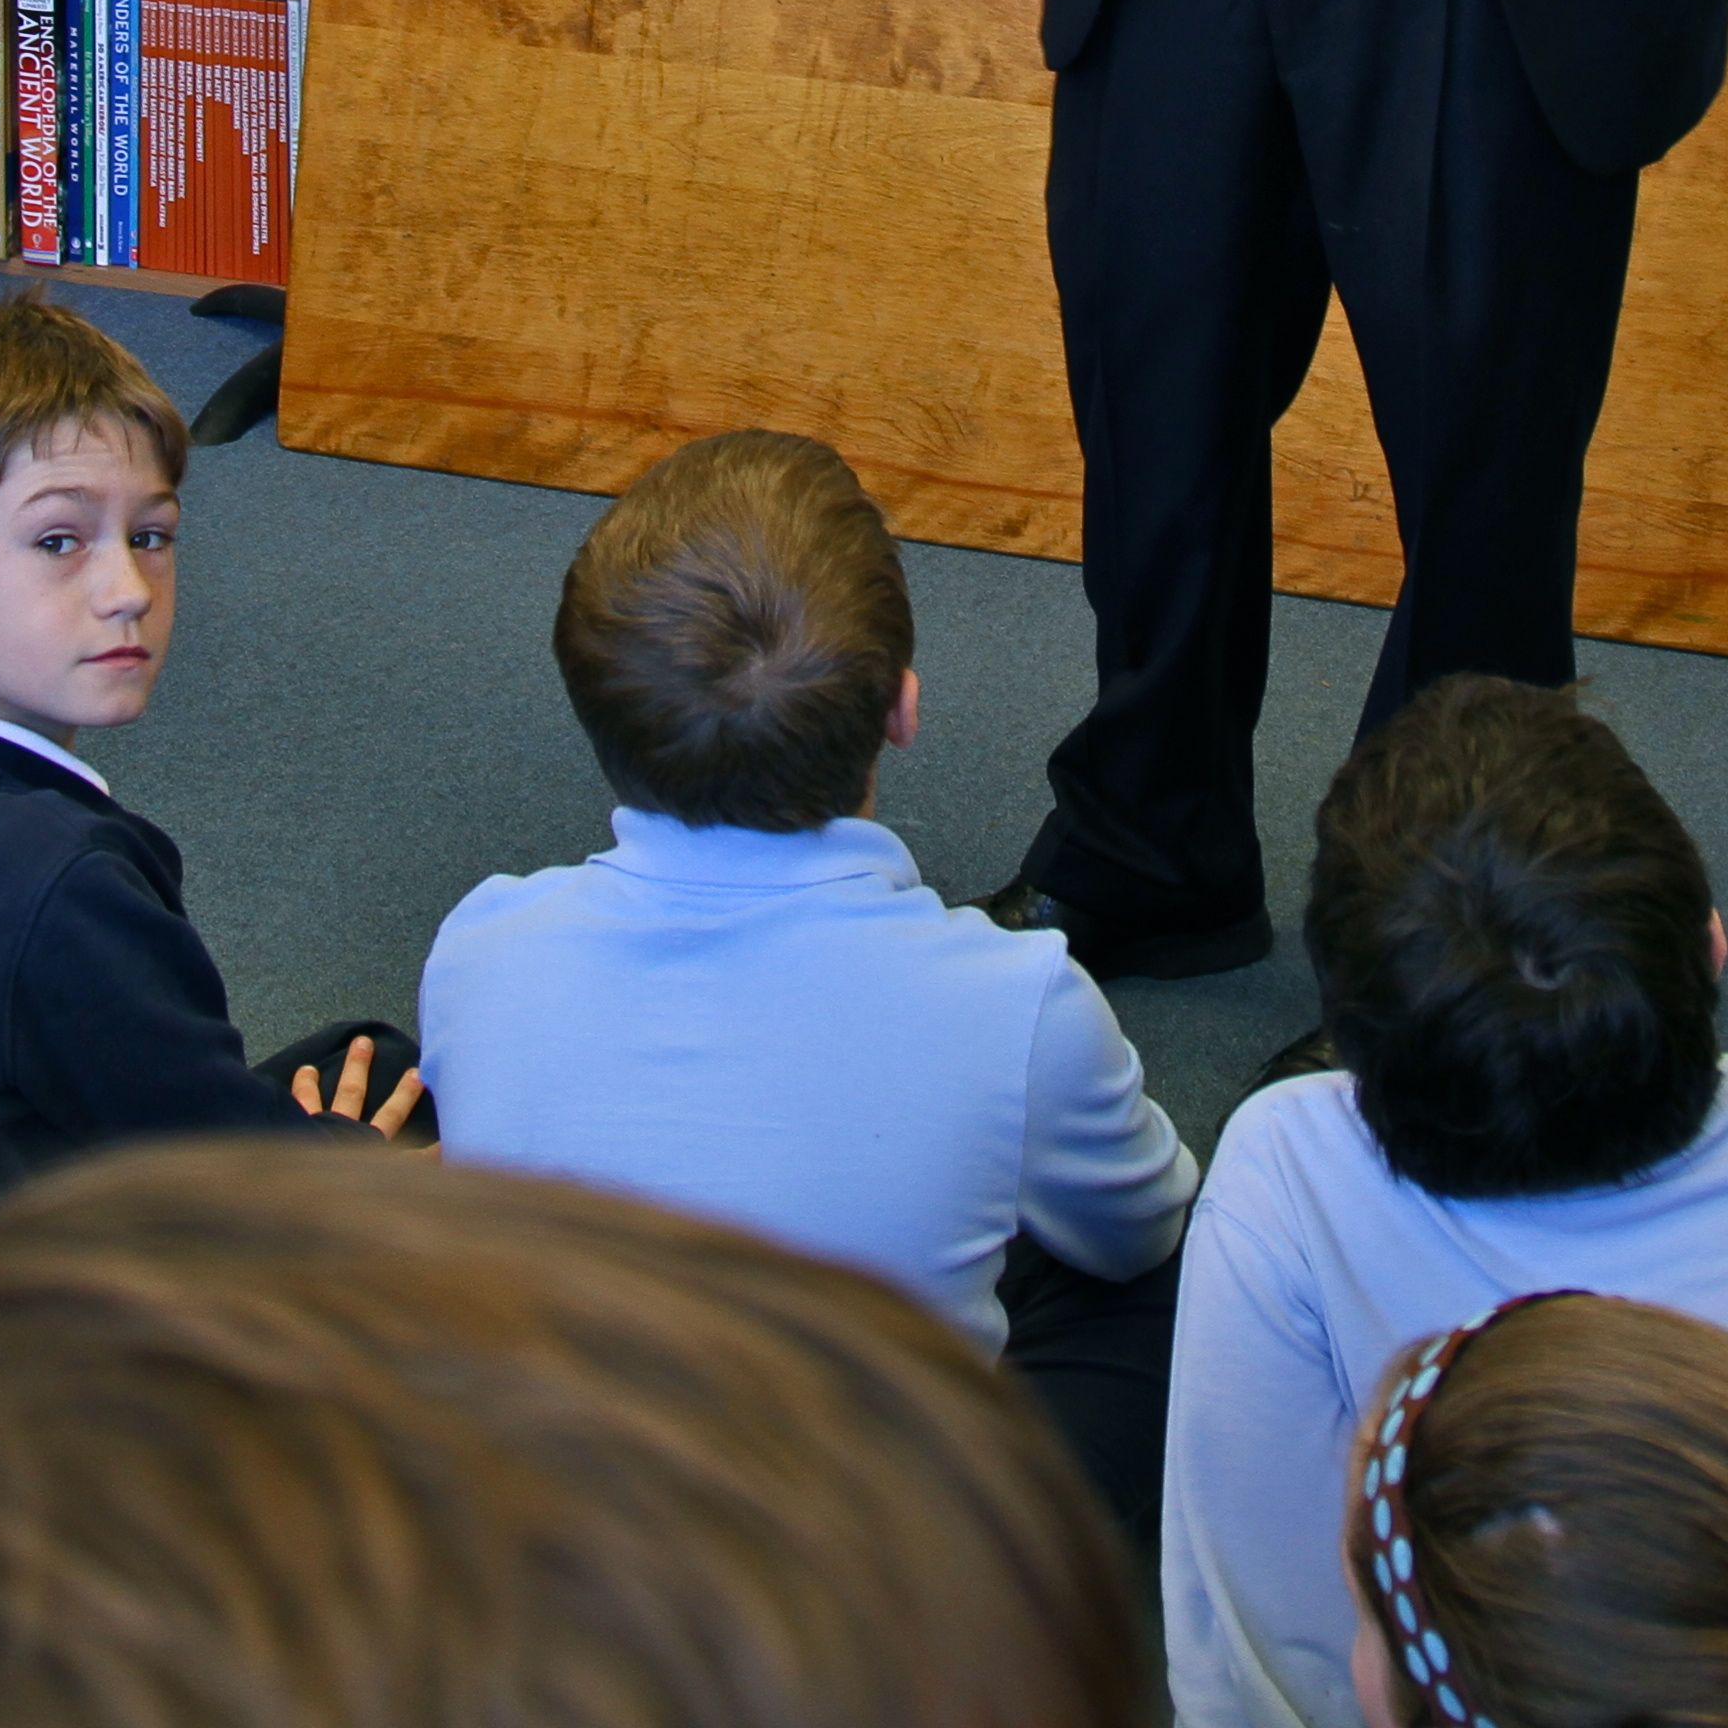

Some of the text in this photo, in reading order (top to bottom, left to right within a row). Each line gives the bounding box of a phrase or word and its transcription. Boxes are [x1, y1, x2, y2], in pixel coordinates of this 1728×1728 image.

[97, 55, 105, 102] AMERICAN
[114, 61, 129, 84] OF
[17, 12, 42, 227] ANCIENT WORLD
[39, 15, 58, 227] ENCYCLOPEDIA OF THE
[69, 27, 80, 182] MATERIAL WORLD
[114, 93, 128, 125] THE
[141, 87, 149, 117] ROMANS
[114, 134, 129, 196] WORLD
